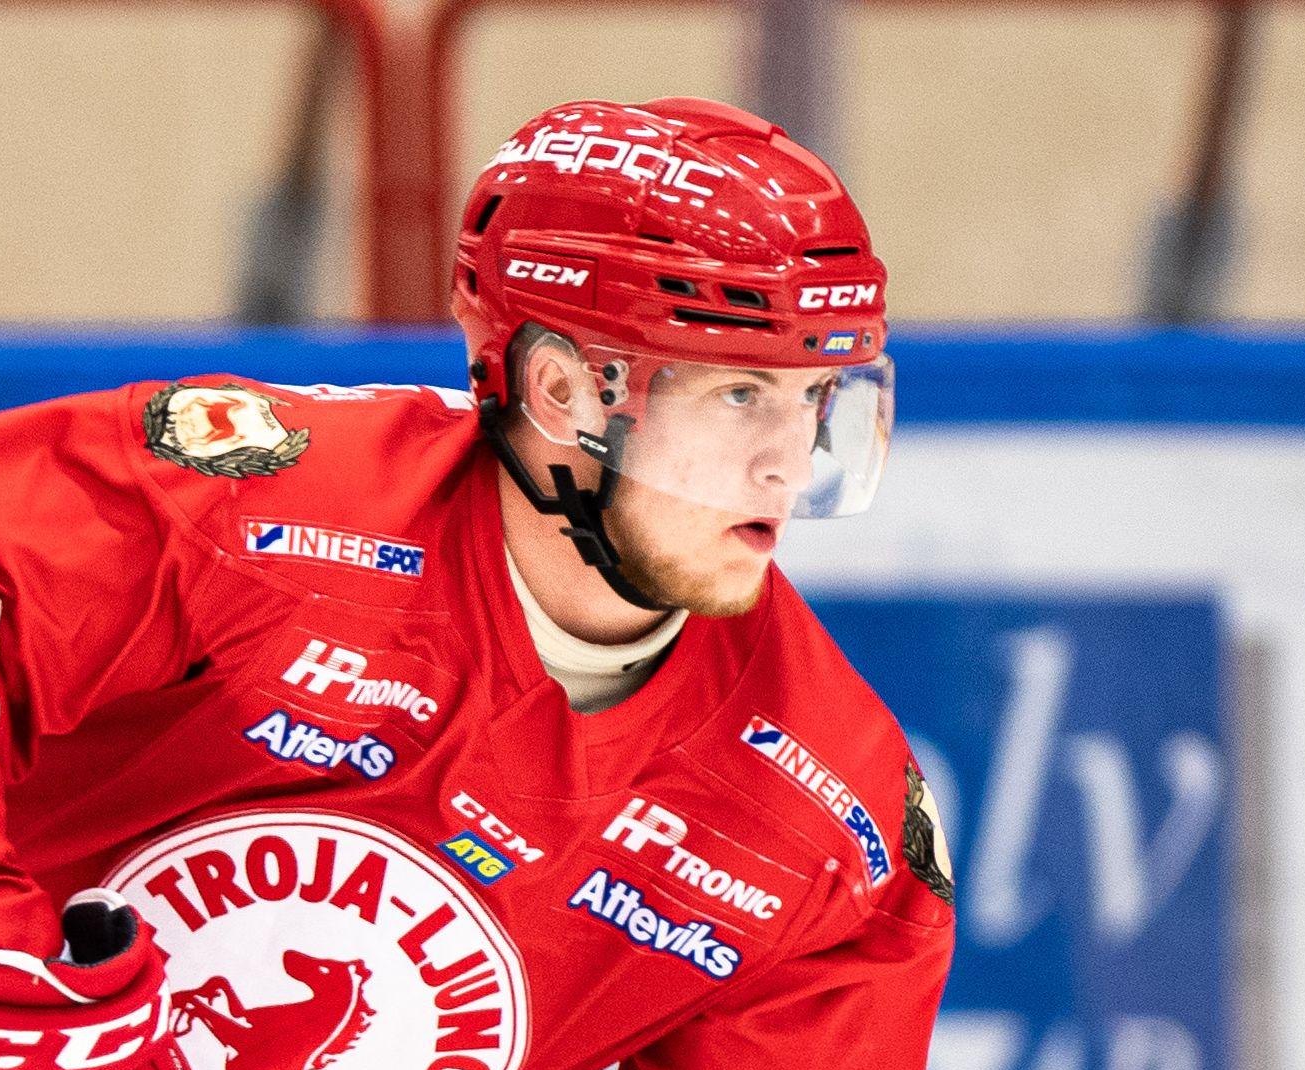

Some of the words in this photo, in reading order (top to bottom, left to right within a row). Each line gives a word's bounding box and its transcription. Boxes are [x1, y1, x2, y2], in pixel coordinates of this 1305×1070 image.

[484, 125, 725, 197] wepac
[506, 259, 590, 287] CCM
[798, 284, 878, 309] CCM
[451, 791, 545, 862] CCM
[445, 837, 508, 878] ATG
[568, 869, 740, 978] Atteviks
